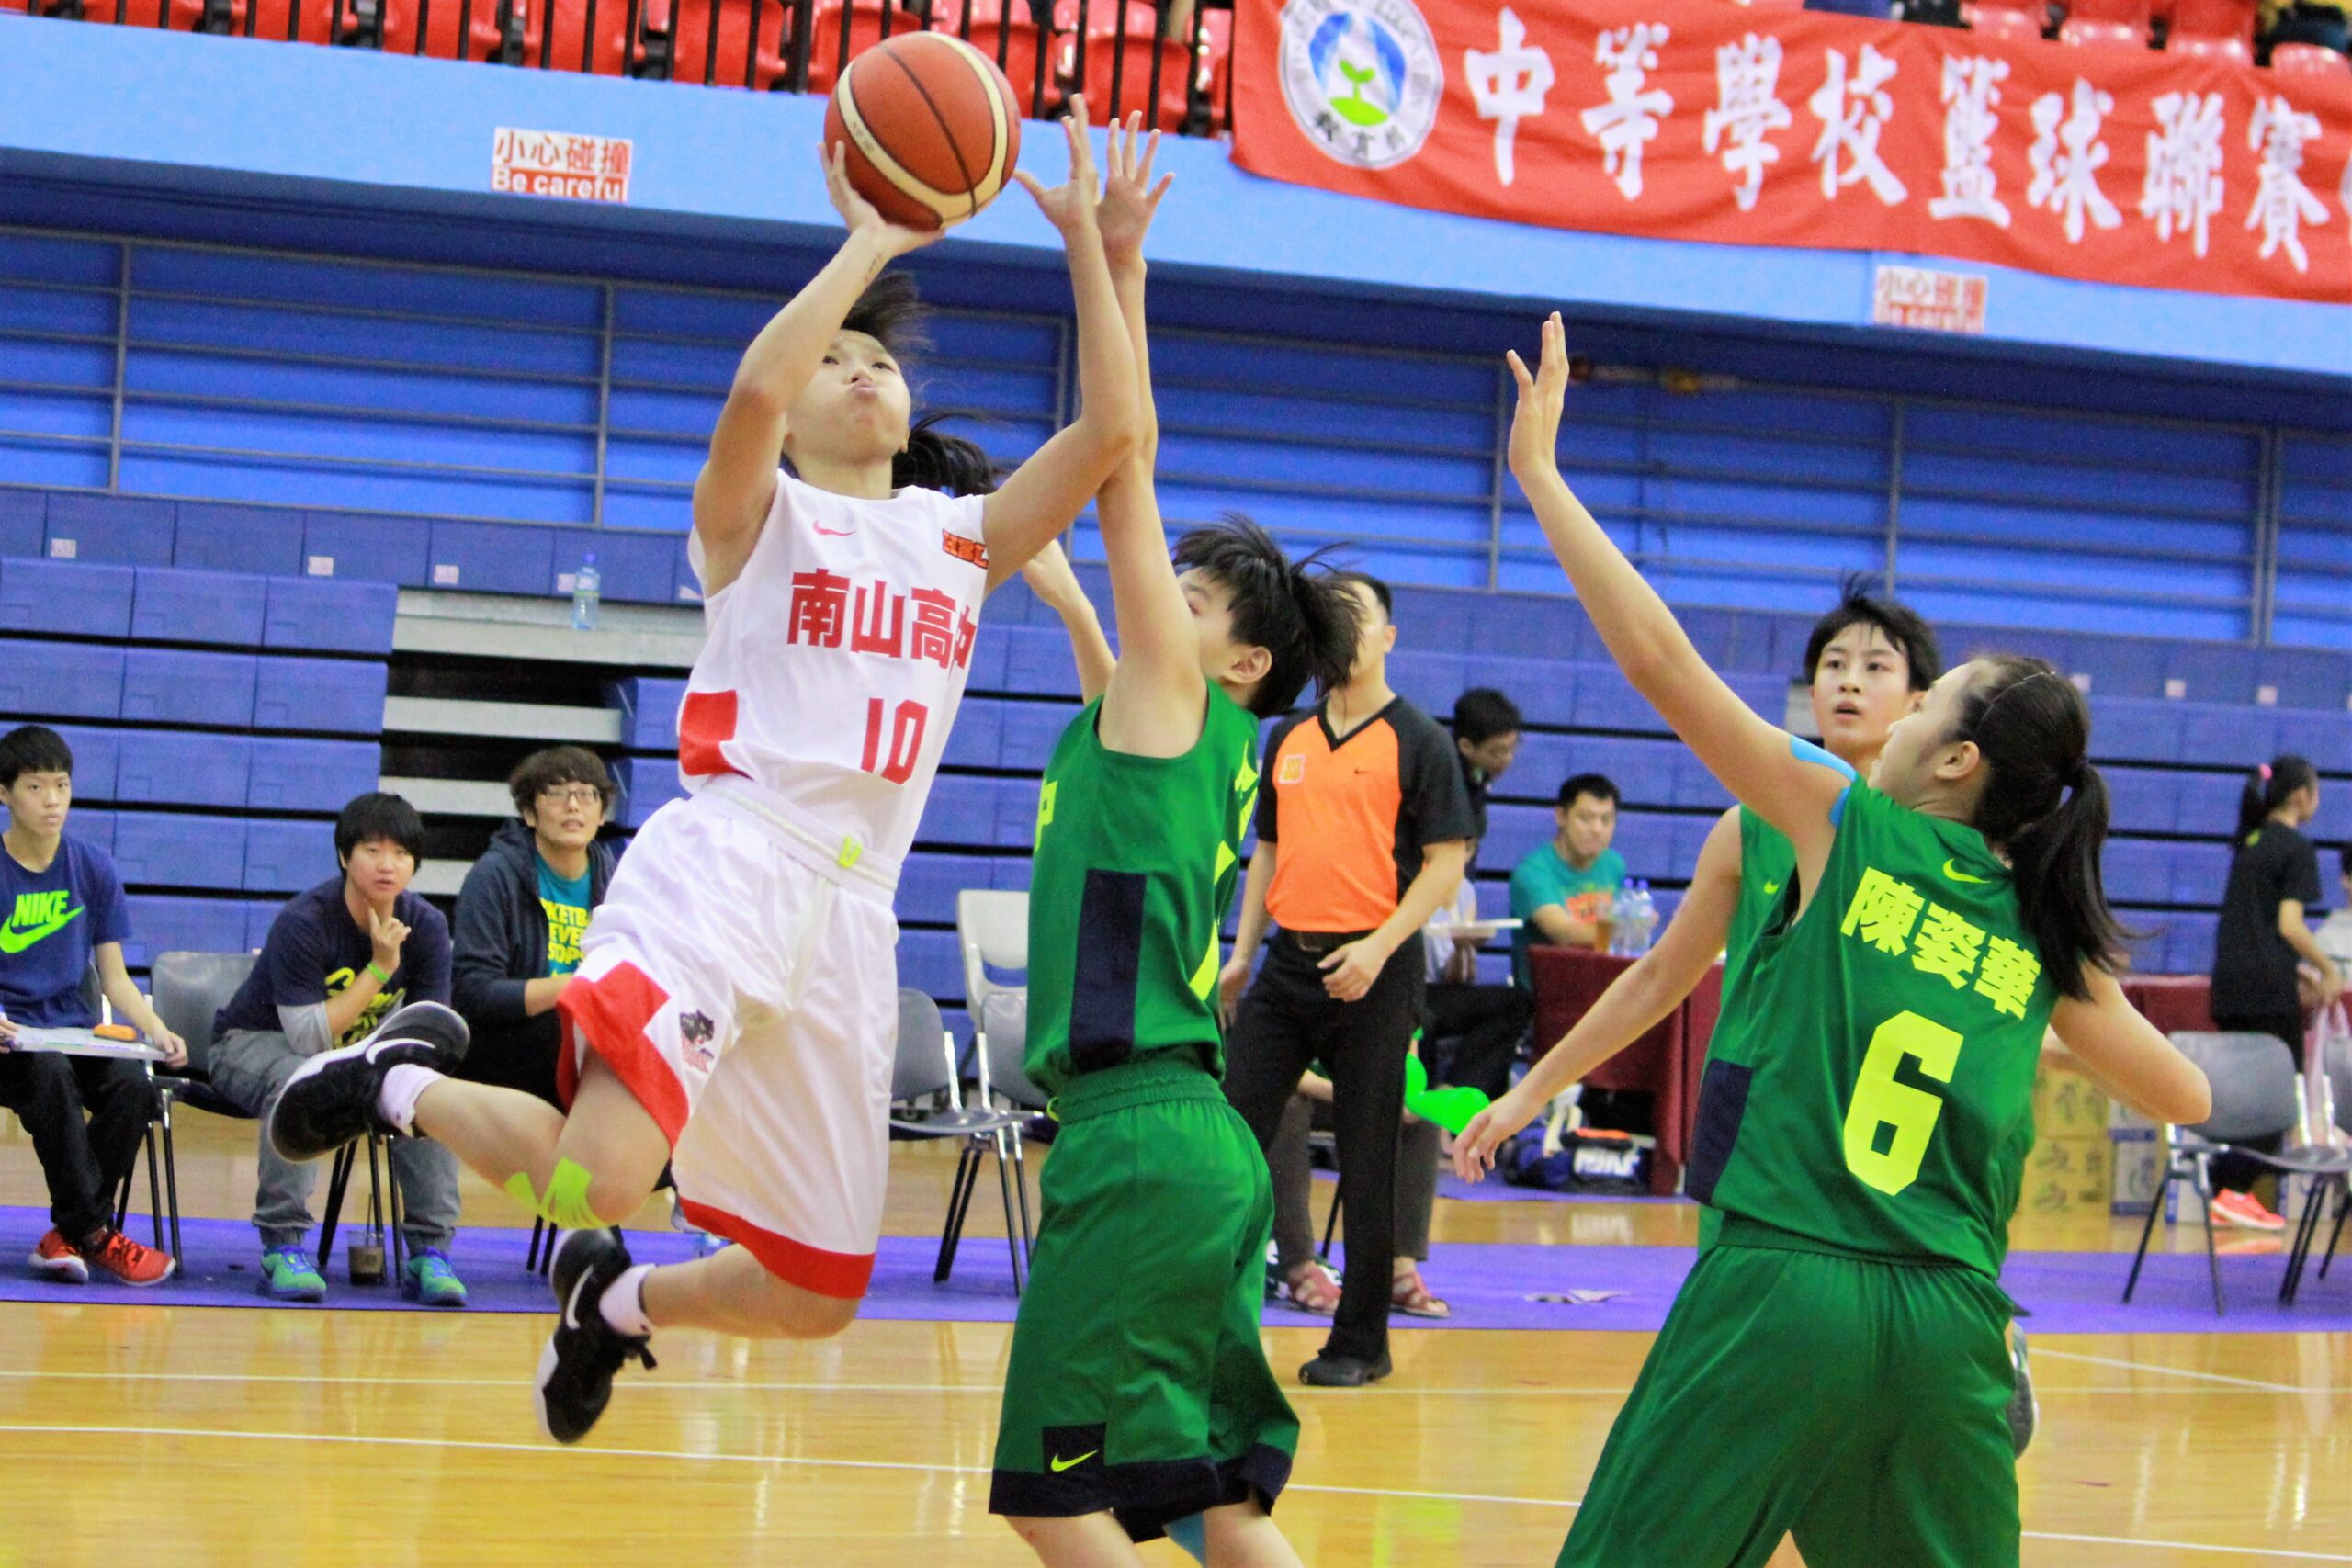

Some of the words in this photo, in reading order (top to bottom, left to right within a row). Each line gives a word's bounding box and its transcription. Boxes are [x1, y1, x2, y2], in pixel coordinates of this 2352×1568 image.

[492, 164, 528, 192] Be
[496, 130, 629, 174] 小心碰撞
[1464, 6, 2329, 274] 中等學校籃球聯賽
[861, 698, 928, 785] 10
[11, 890, 70, 928] NIKE
[1840, 866, 2041, 1021] 陳姿華
[1844, 1010, 1964, 1196] 6
